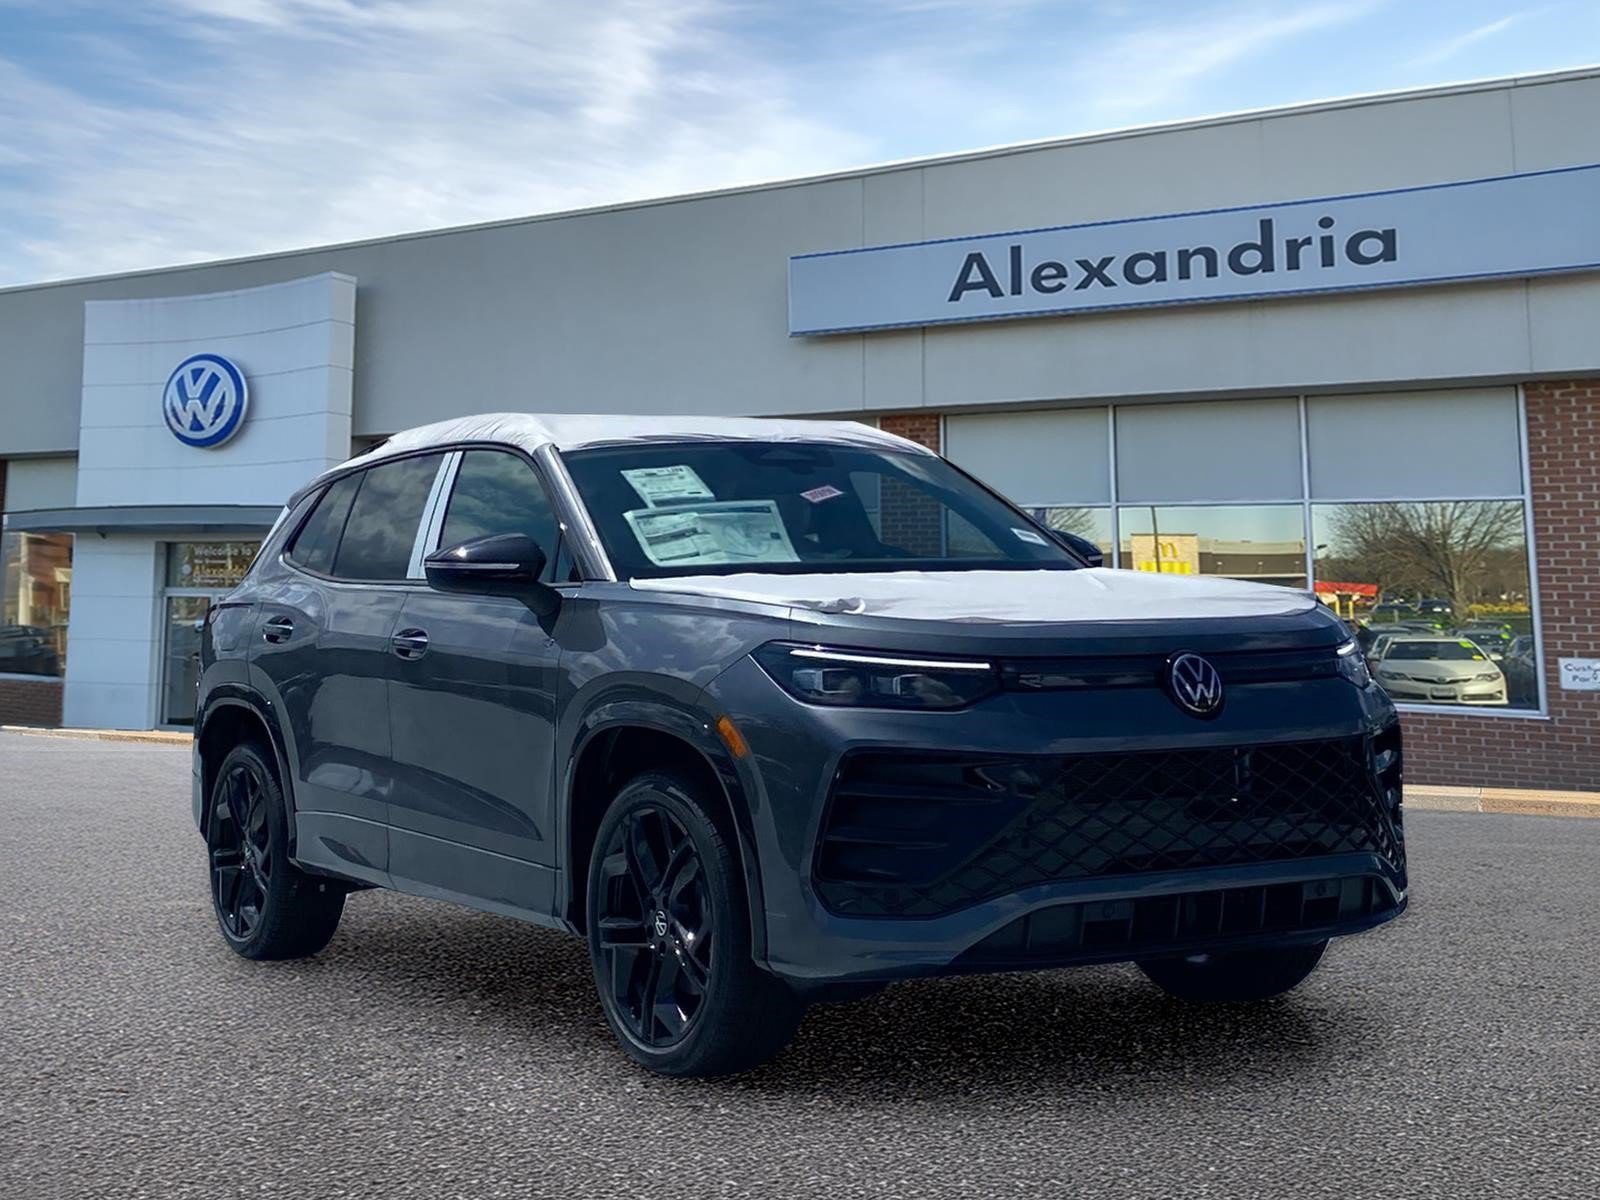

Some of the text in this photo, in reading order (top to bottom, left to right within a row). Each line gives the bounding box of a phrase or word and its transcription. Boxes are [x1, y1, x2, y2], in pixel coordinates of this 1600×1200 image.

[948, 216, 1397, 302] Alexandria
[166, 358, 238, 441] VW
[1172, 653, 1221, 712] VW
